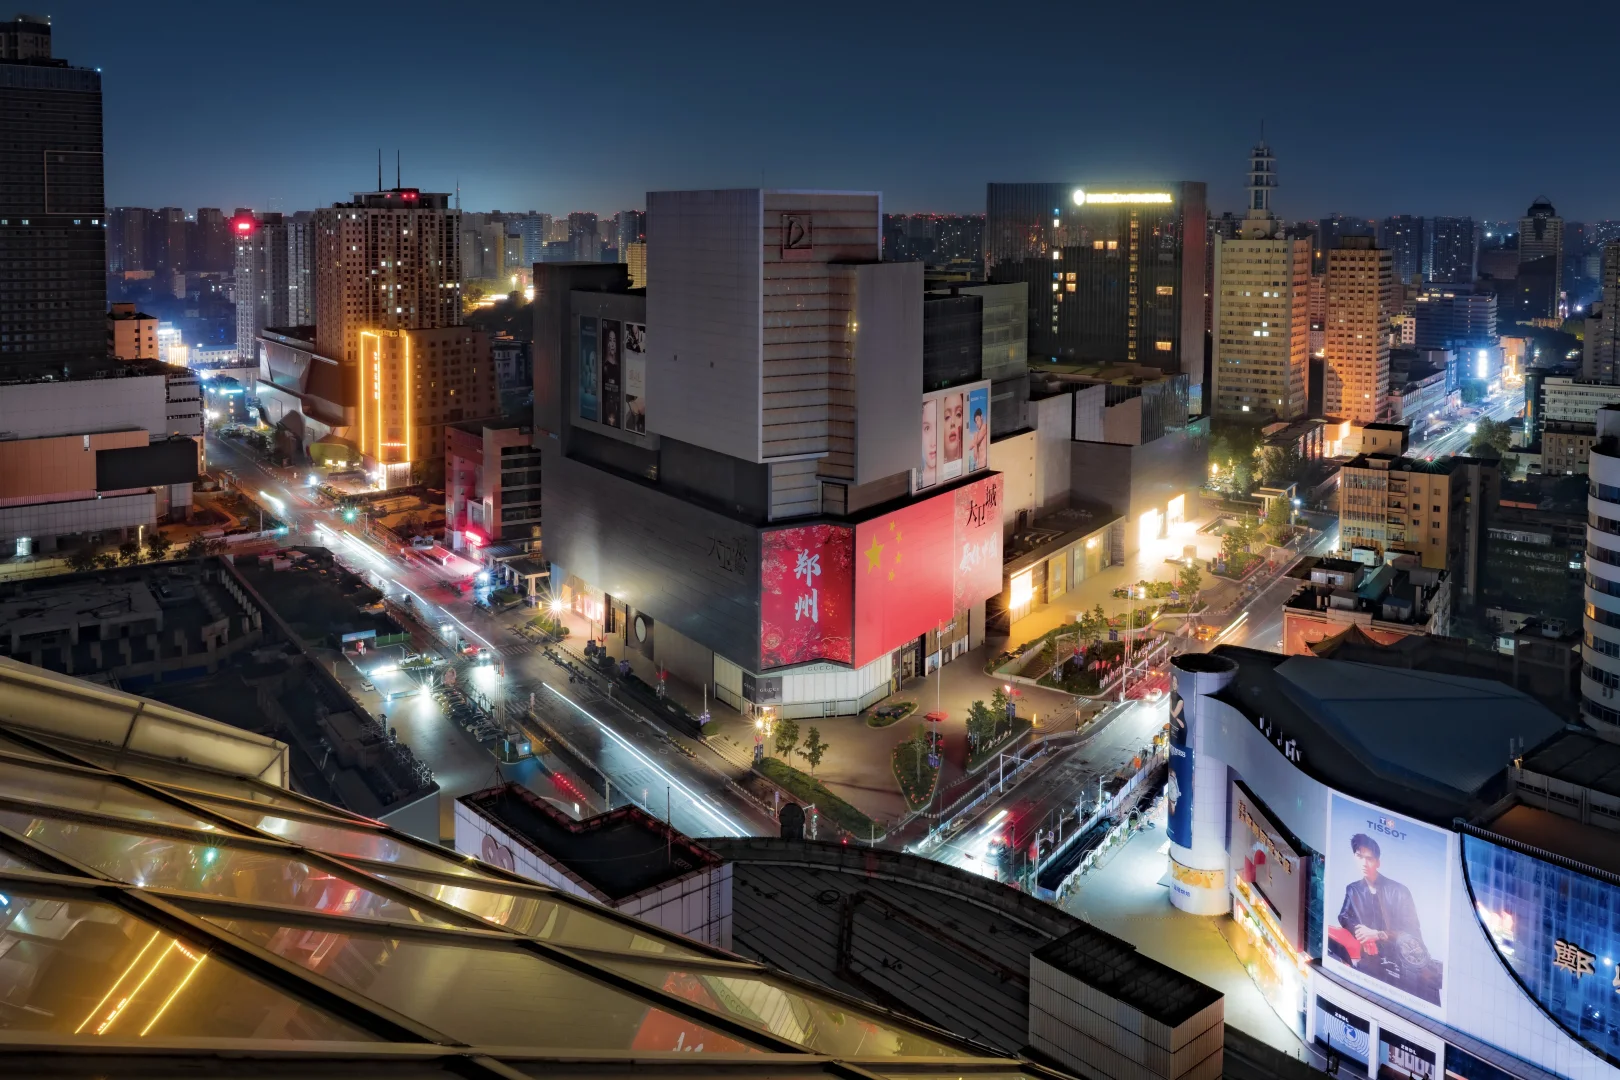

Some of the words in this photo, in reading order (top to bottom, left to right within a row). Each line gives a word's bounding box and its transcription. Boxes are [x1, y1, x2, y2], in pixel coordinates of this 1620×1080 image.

[966, 484, 997, 529] 大卫城
[793, 548, 822, 624] 郑州
[807, 664, 834, 672] GUCCI
[1366, 819, 1407, 841] TISSOT
